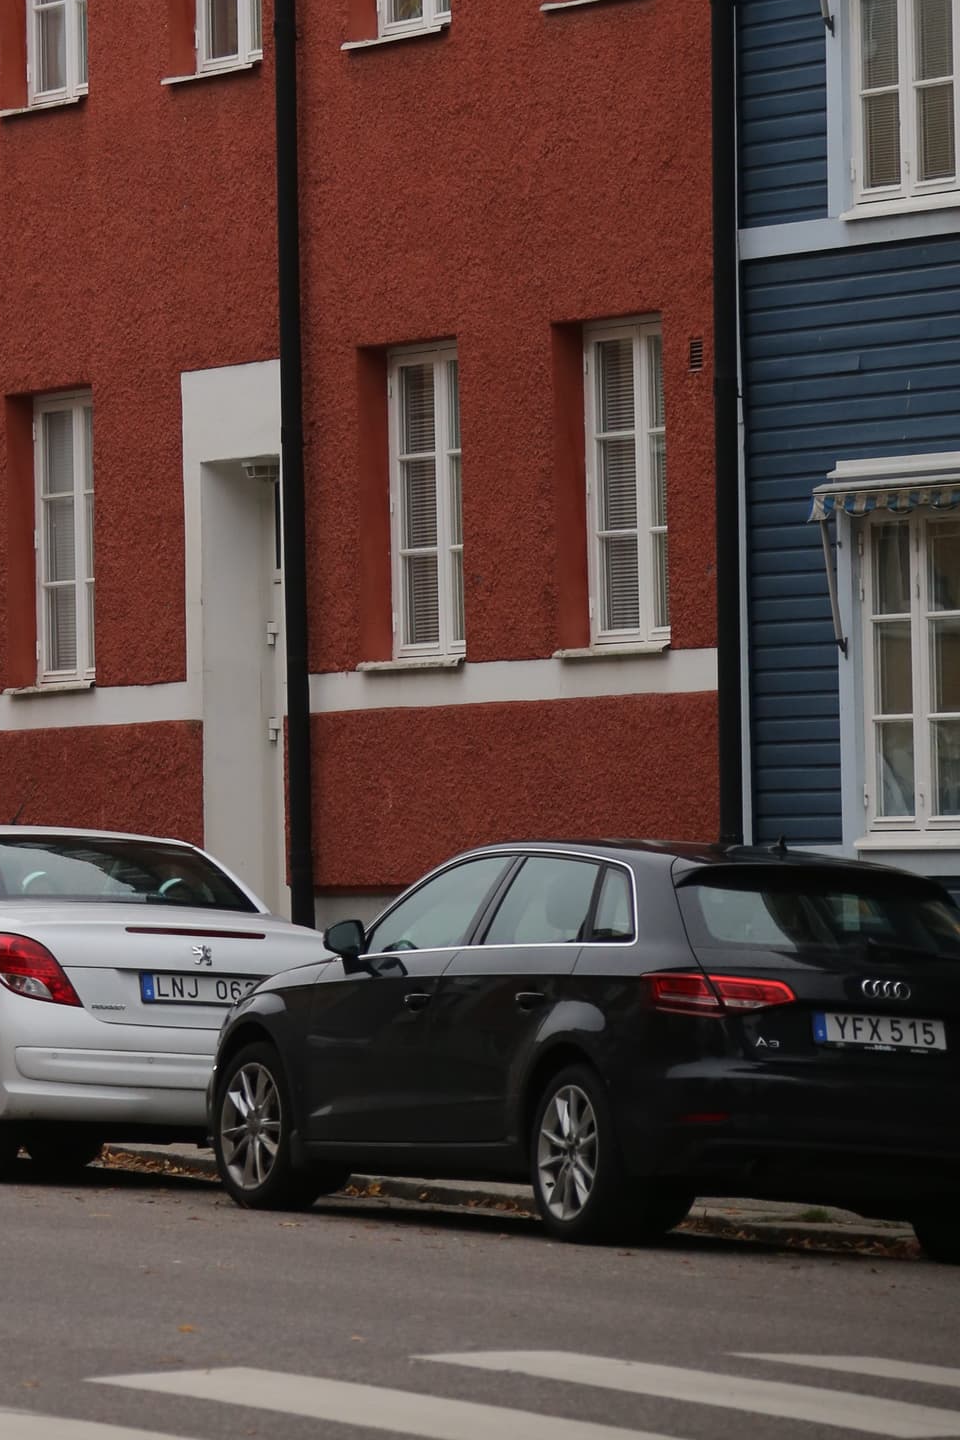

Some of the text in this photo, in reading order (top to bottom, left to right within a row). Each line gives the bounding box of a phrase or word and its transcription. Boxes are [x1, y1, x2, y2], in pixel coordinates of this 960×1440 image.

[156, 977, 254, 1000] LNJ 06
[755, 1036, 780, 1048] A3
[835, 1016, 936, 1045] YFX 515
